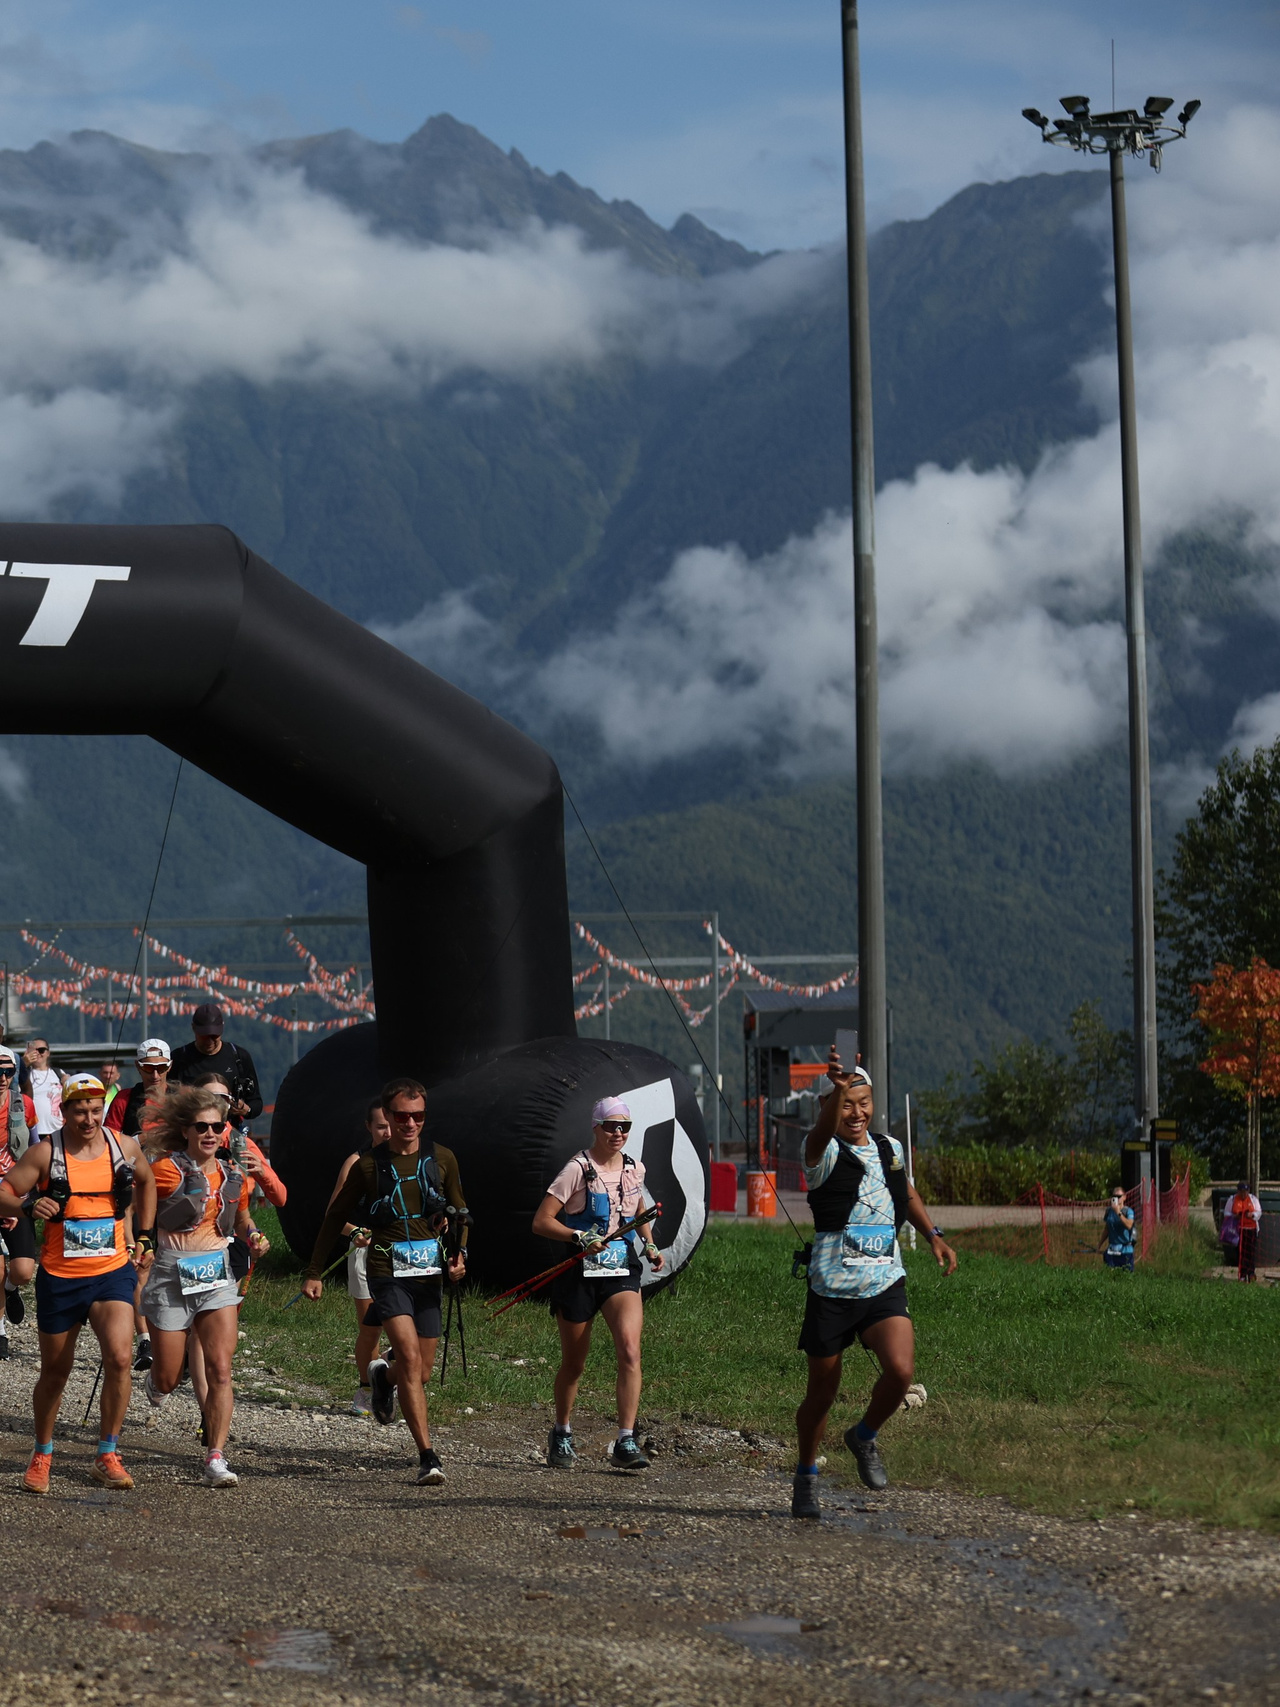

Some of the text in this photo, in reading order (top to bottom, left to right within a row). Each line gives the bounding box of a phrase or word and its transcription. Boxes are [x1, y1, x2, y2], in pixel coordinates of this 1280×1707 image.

[76, 1230, 102, 1245] 154
[857, 1237, 883, 1252] 140
[404, 1249, 429, 1264] 134
[596, 1250, 619, 1265] 124
[191, 1263, 215, 1280] 128
